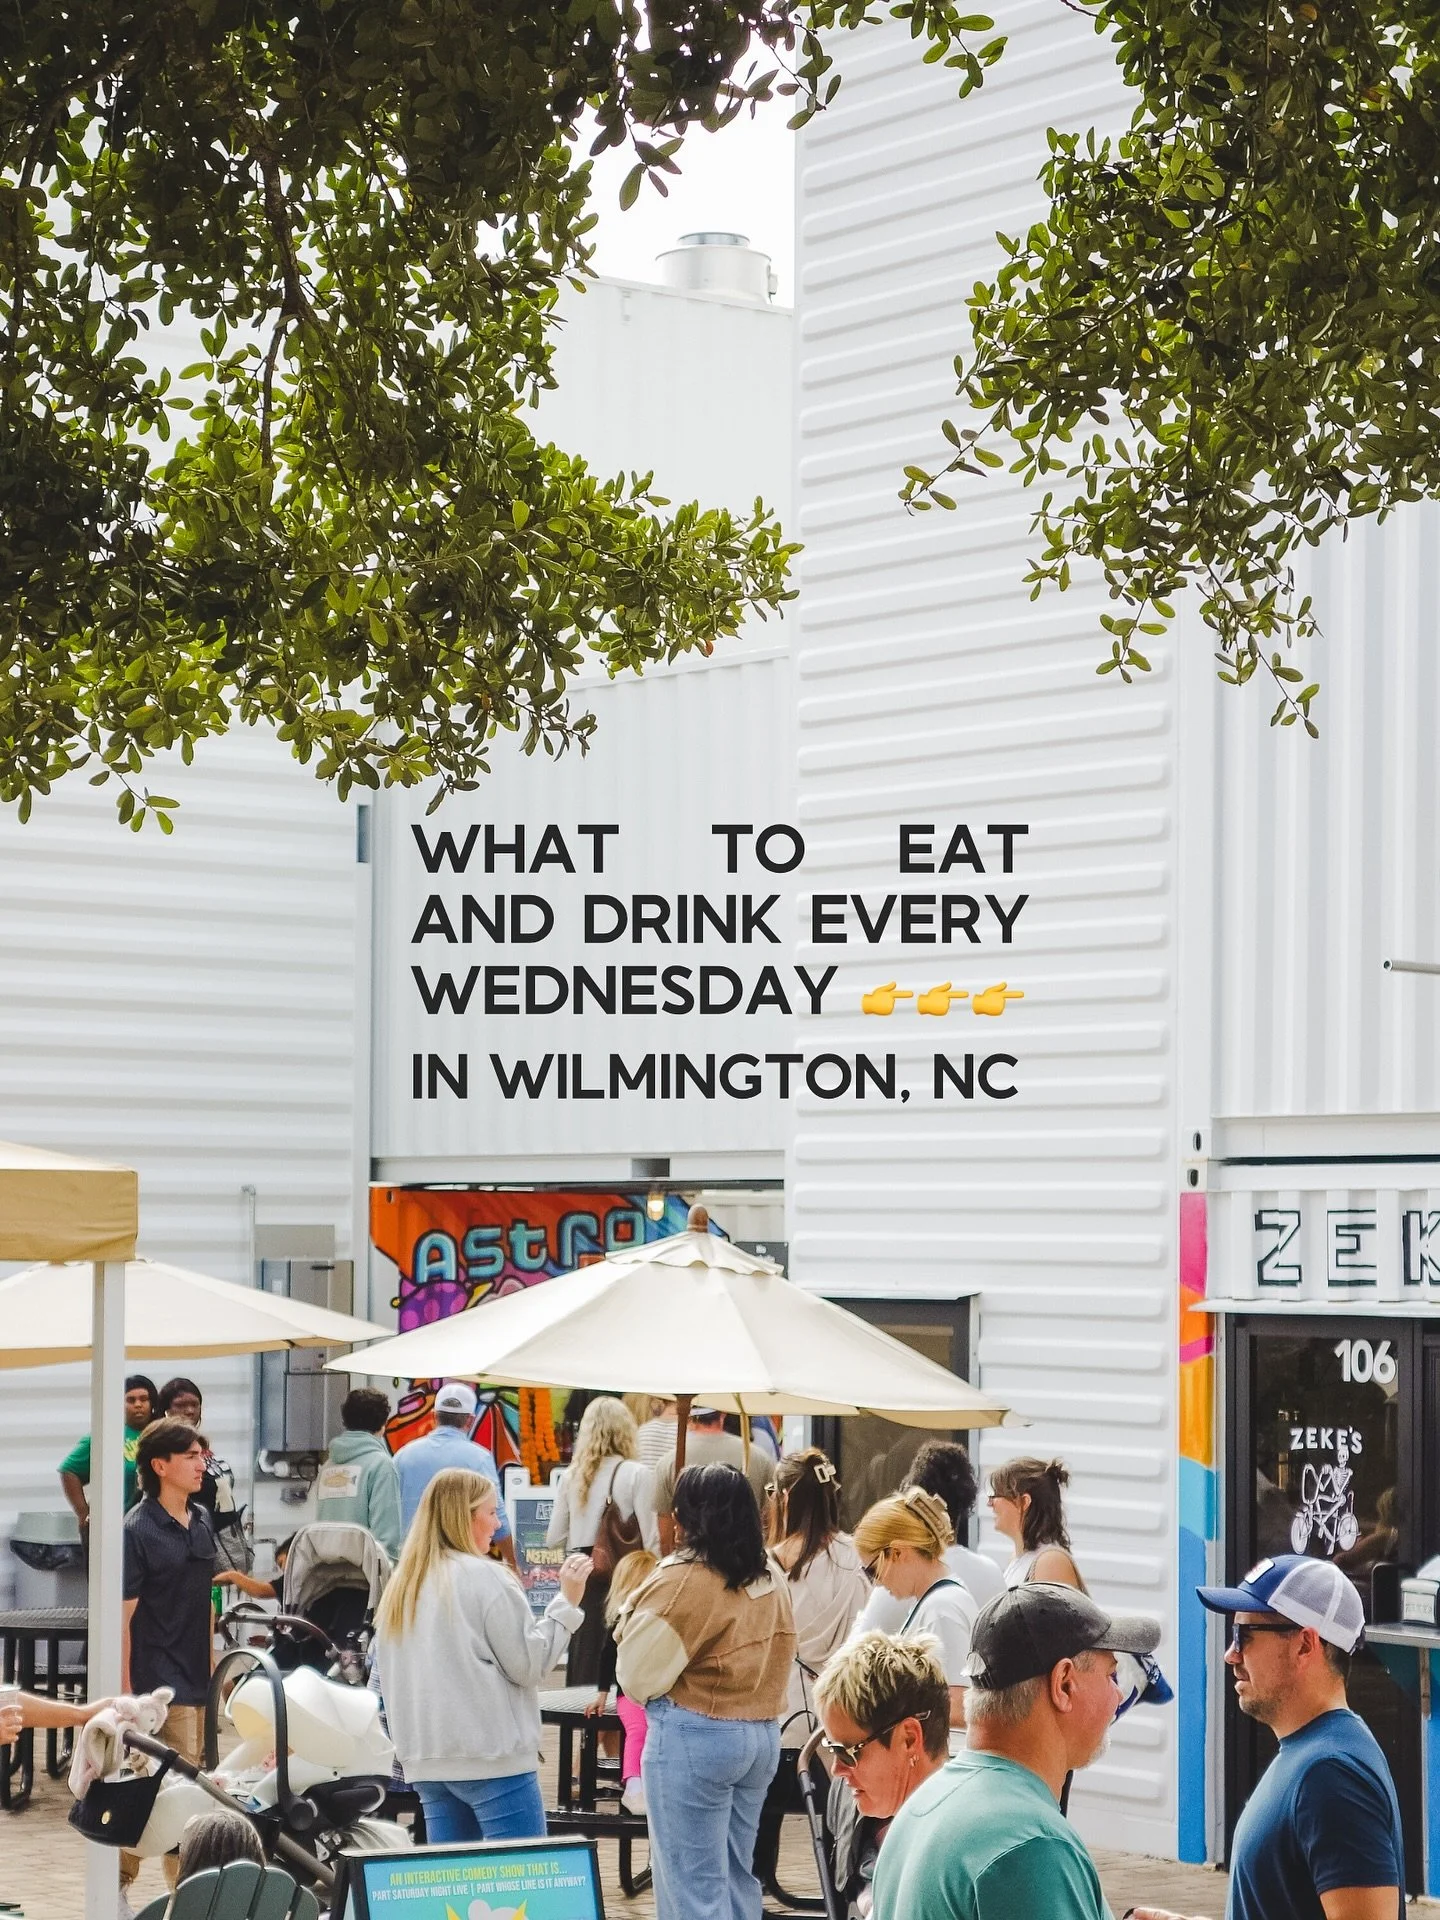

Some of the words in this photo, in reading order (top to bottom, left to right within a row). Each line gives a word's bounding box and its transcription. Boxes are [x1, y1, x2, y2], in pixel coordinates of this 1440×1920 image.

[1334, 1339, 1398, 1385] 106
[1290, 1426, 1363, 1454] ZEKE'S
[390, 1872, 402, 1886] AN
[404, 1869, 462, 1885] INTERACTIVE
[462, 1866, 497, 1882] COMEDY
[499, 1864, 525, 1879] SHOW
[527, 1862, 549, 1876] THAT
[476, 1882, 495, 1893] PART
[496, 1880, 520, 1892] WHOSE
[521, 1879, 537, 1890] LINE
[537, 1879, 545, 1889] IS
[545, 1878, 552, 1889] IT
[554, 1876, 586, 1888] ANYWAY?
[372, 1889, 391, 1901] PART
[392, 1887, 430, 1900] SATURDAY
[431, 1885, 451, 1897] NIGHT
[453, 1884, 469, 1895] LIVE
